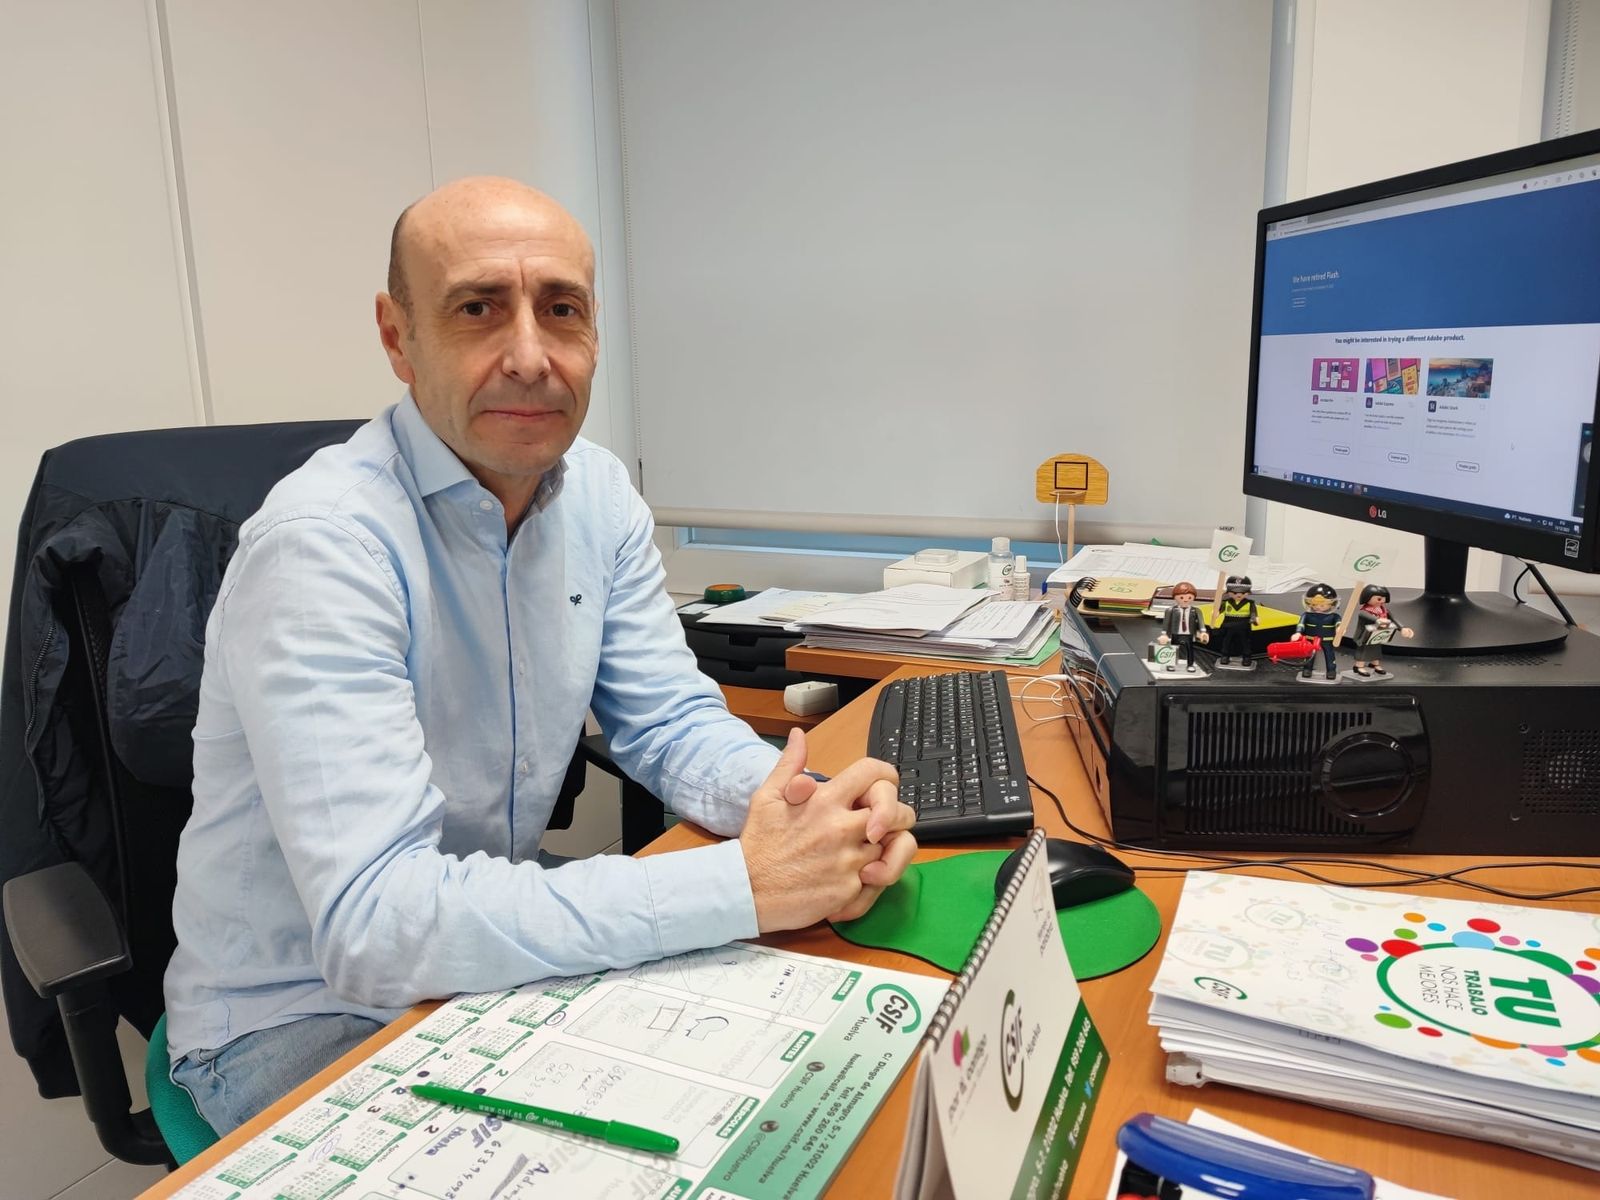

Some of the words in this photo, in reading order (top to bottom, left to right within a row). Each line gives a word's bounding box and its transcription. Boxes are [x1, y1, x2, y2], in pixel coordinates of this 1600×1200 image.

[836, 977, 856, 995] LUNES
[1418, 964, 1438, 1003] MEJORES
[1439, 965, 1457, 984] NOS
[1443, 986, 1462, 1010] HACE
[1463, 970, 1488, 1016] TRABAJO
[1489, 970, 1563, 1028] TU
[875, 995, 909, 1033] CSIF
[842, 1016, 868, 1040] Huelva
[784, 1035, 808, 1058] MARTES
[819, 1053, 860, 1100] huelva@csif.es
[866, 1062, 886, 1079] Diego
[779, 1086, 802, 1108] Huelva
[836, 1086, 853, 1099] Telf.
[1054, 1087, 1069, 1120] Huelva
[479, 1104, 522, 1119] www.csif.es
[543, 1117, 563, 1128] Huelva
[825, 1102, 841, 1115] 959
[813, 1118, 830, 1133] 260
[425, 1126, 466, 1156] Huelva
[757, 1107, 819, 1183] www.csif.es/huelva
[801, 1135, 818, 1151] 645
[803, 1142, 828, 1169] 21002
[780, 1170, 808, 1200] Huelva
